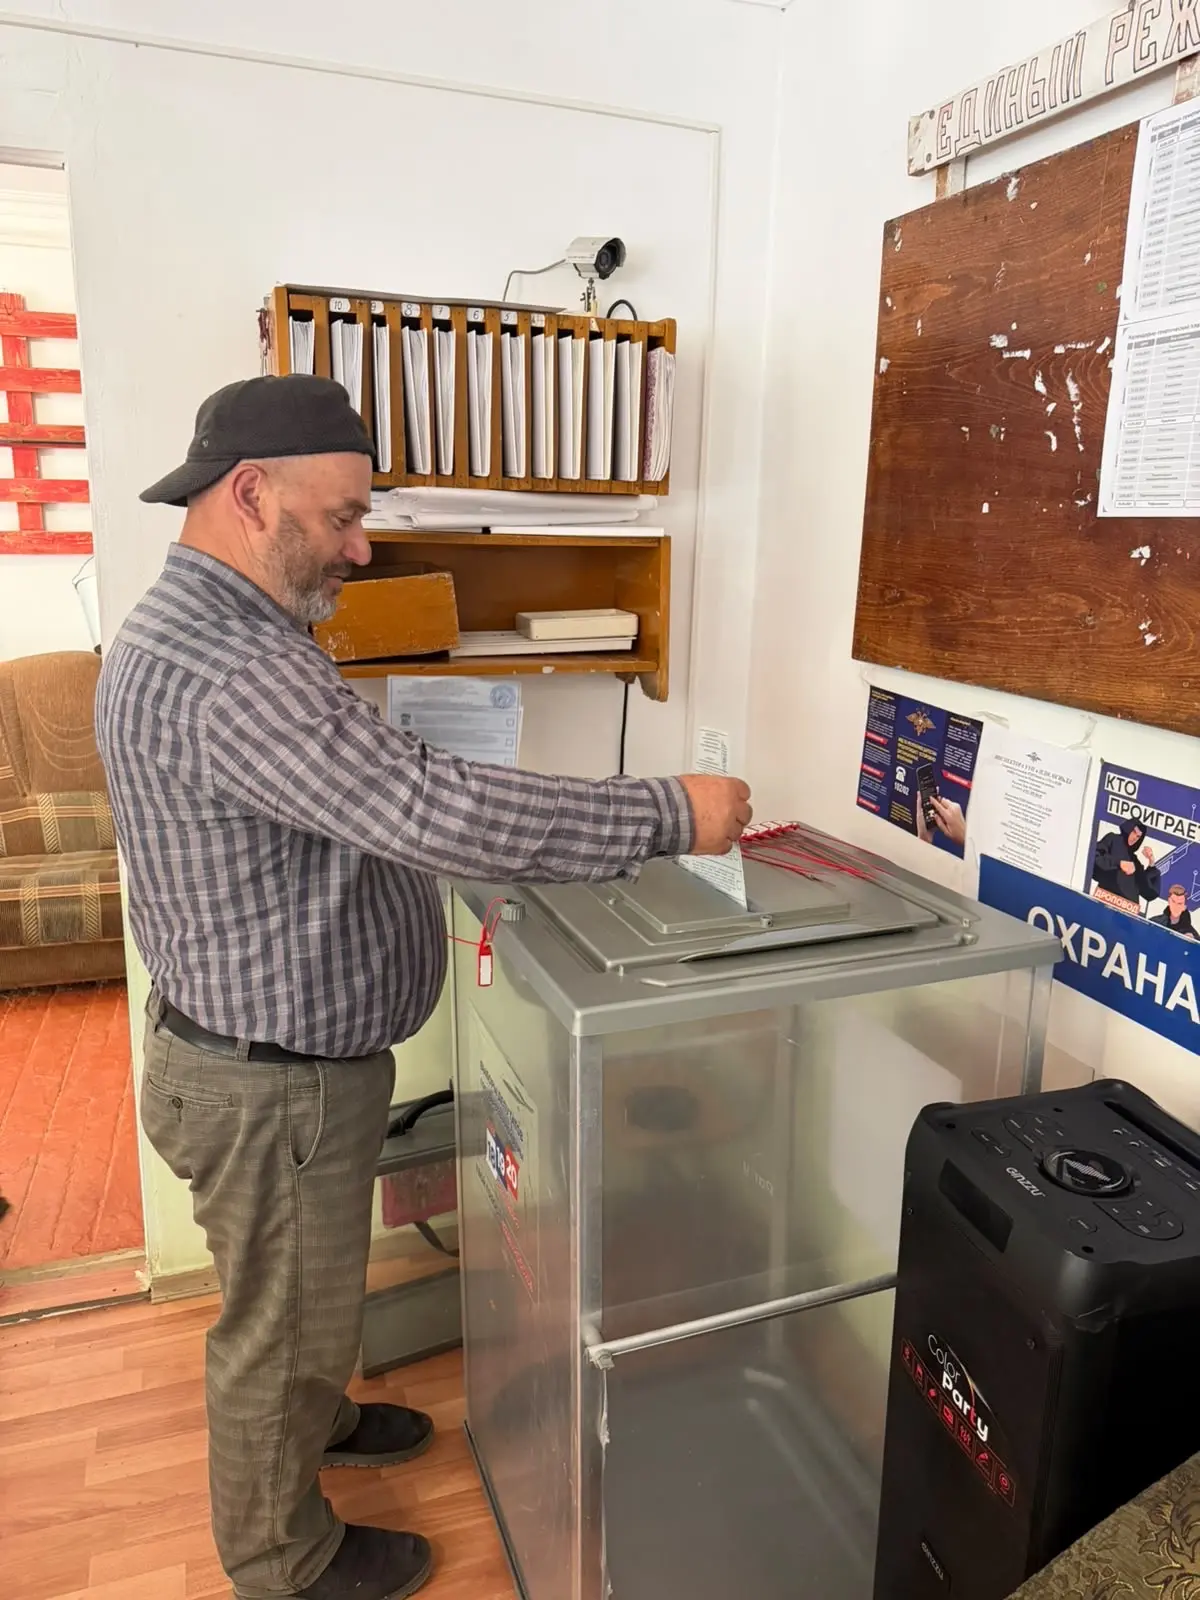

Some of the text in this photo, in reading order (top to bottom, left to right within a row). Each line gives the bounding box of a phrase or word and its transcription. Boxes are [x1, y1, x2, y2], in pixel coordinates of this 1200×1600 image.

[936, 30, 1087, 159] ЕДИНЫЙ
[404, 303, 413, 316] 8
[438, 306, 444, 315] 7
[473, 310, 479, 320] 6
[503, 312, 510, 321] 5
[1106, 774, 1137, 797] КТО
[1108, 797, 1200, 840] ПРОИГРАЕ
[1095, 887, 1140, 914] ДРОПОВОД
[505, 1154, 517, 1190] 20
[928, 1334, 962, 1383] Color
[941, 1371, 989, 1442] Party
